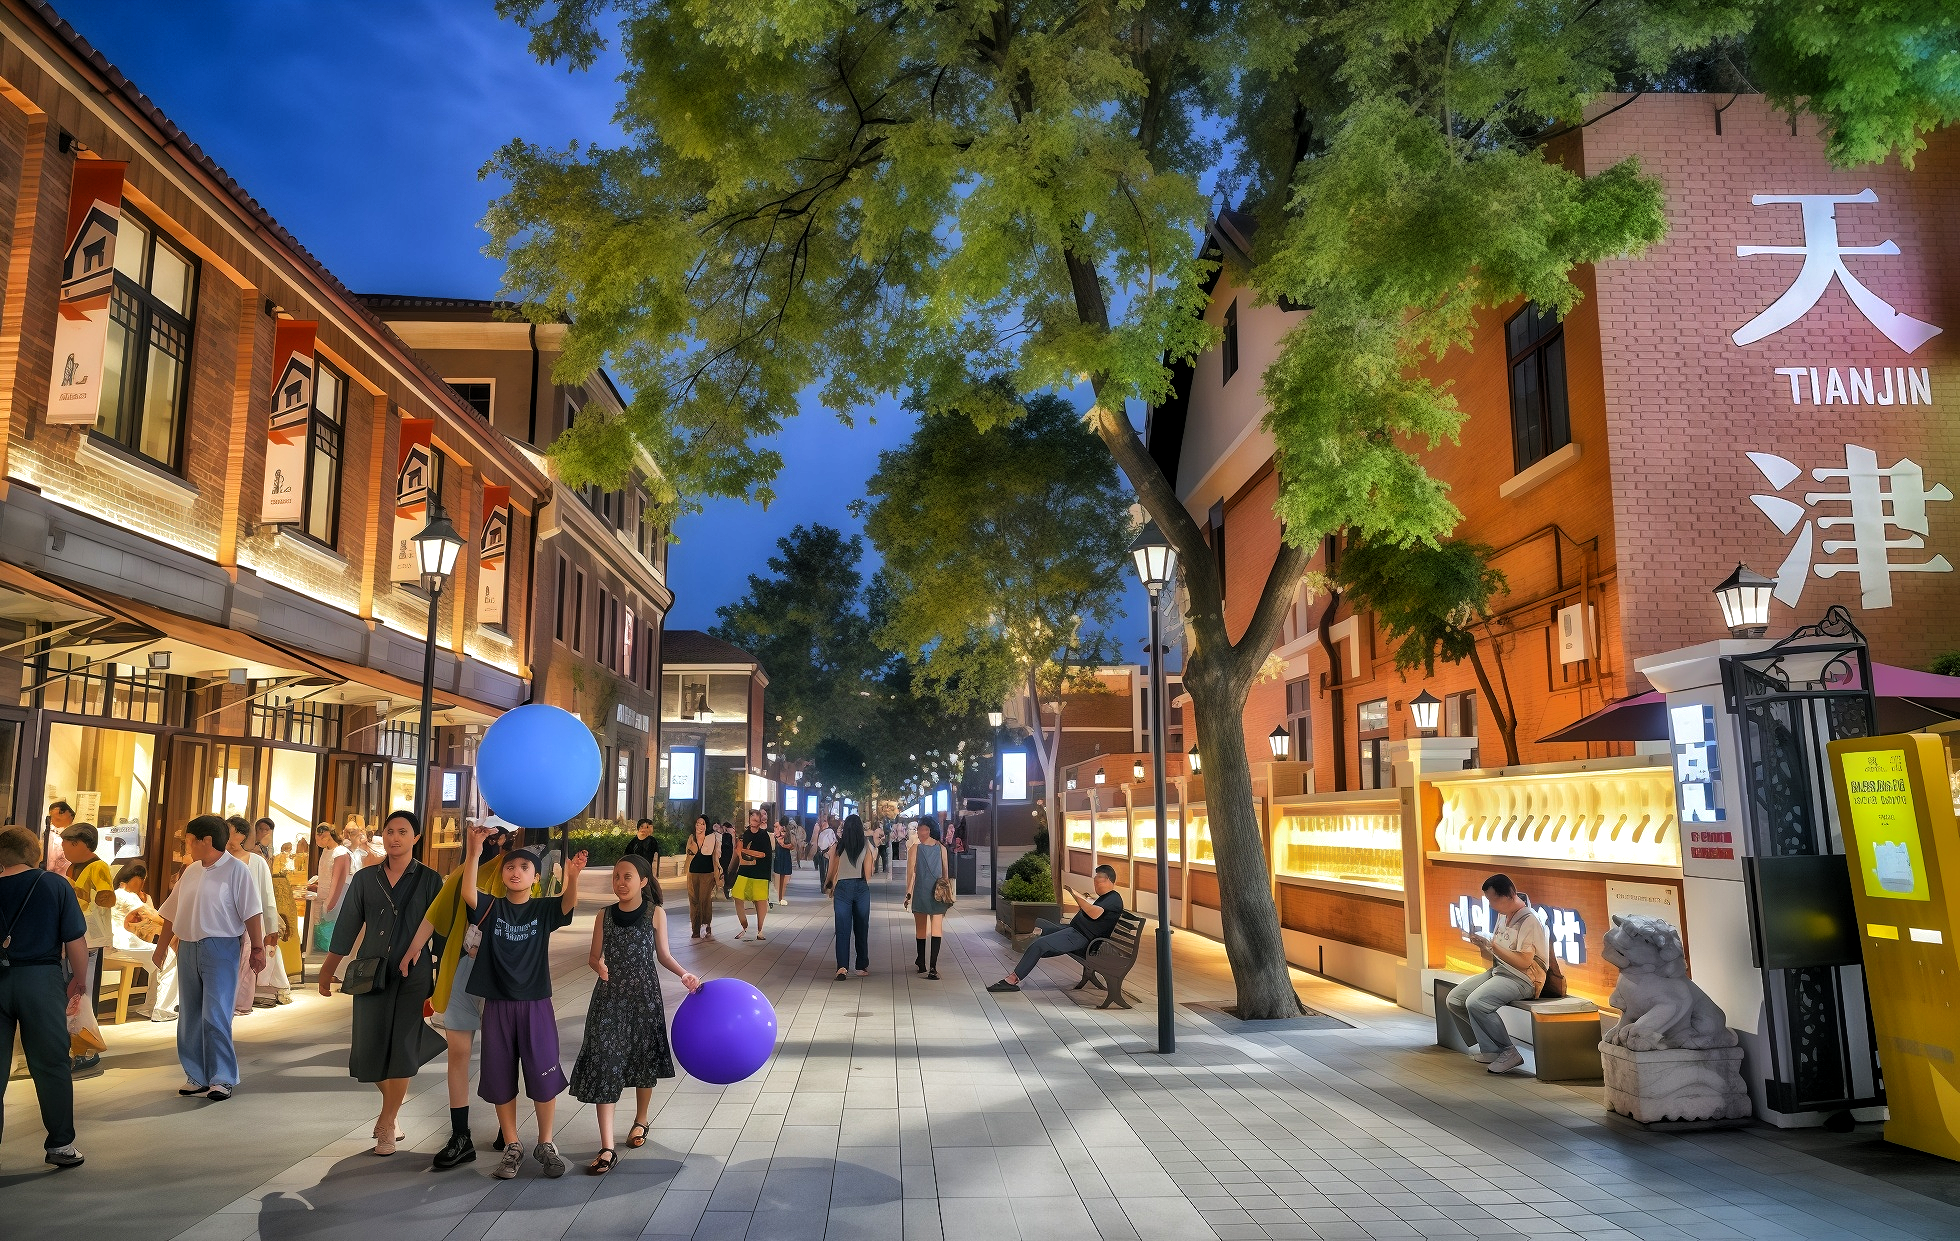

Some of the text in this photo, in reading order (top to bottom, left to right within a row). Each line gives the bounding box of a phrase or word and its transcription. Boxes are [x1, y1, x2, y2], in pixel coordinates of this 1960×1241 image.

[1731, 187, 1943, 354] 天
[1775, 367, 1932, 406] TIANJIN
[1745, 443, 1954, 609] 津
